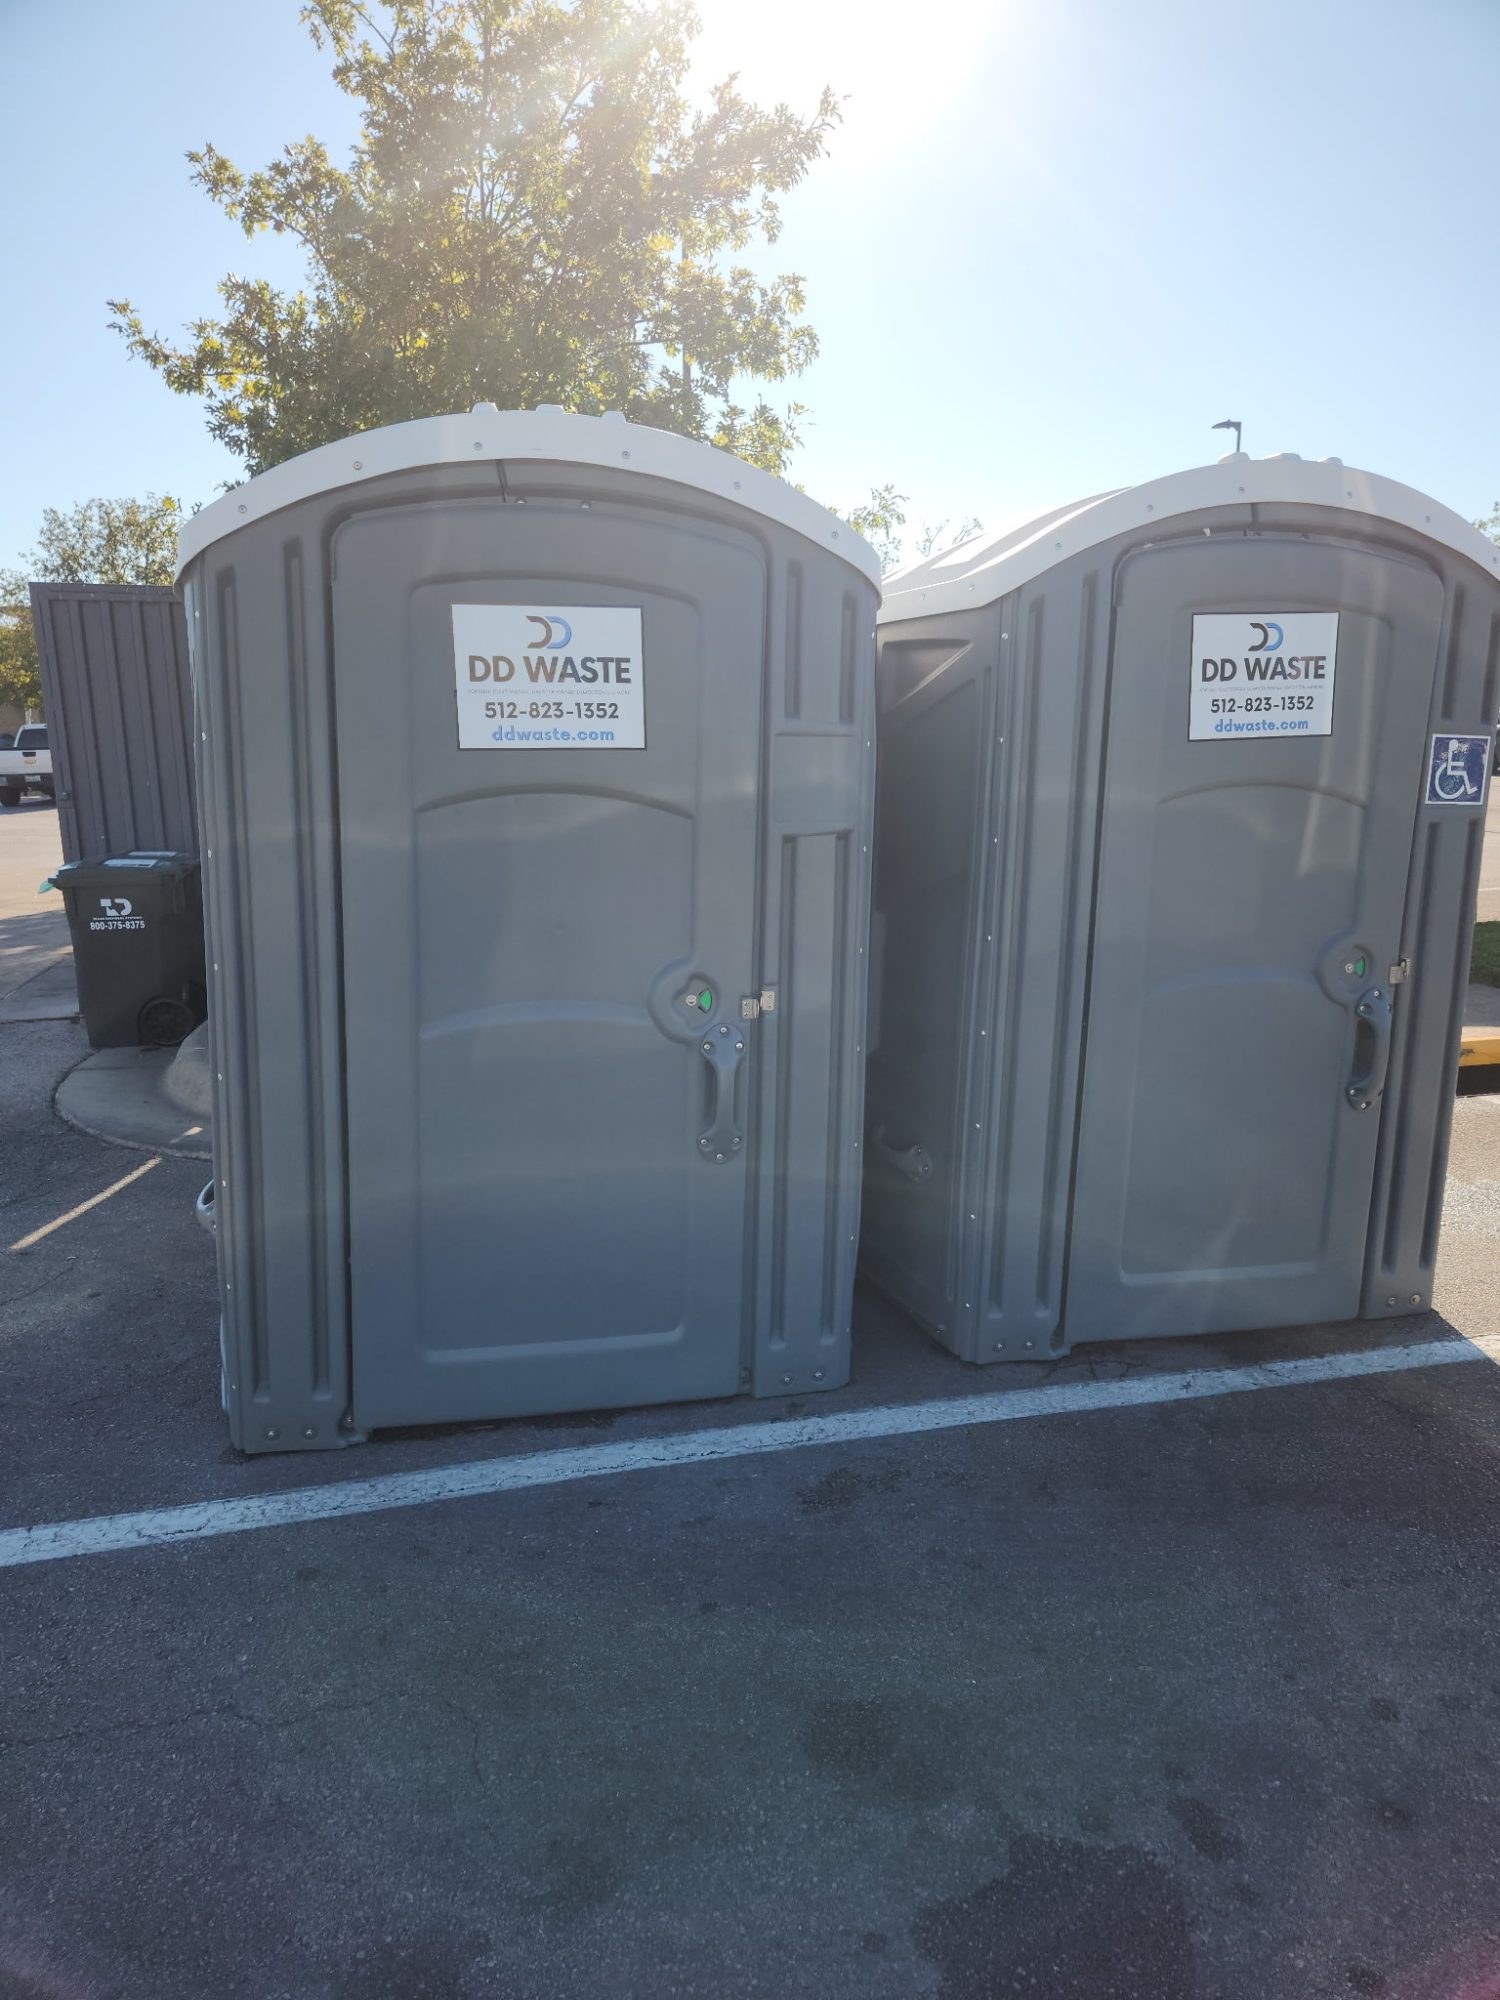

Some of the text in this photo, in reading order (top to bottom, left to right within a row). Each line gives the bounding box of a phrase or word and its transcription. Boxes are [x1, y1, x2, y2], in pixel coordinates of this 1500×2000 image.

[468, 655, 632, 684] DD WASTE
[1201, 655, 1327, 682] DD WASTE
[484, 702, 619, 719] 512-823-1352
[1210, 696, 1314, 713] 512-823-1352
[492, 725, 615, 742] ddwaste.com
[1214, 718, 1309, 733] ddwaste.com
[90, 920, 146, 930] 800-375-8375
